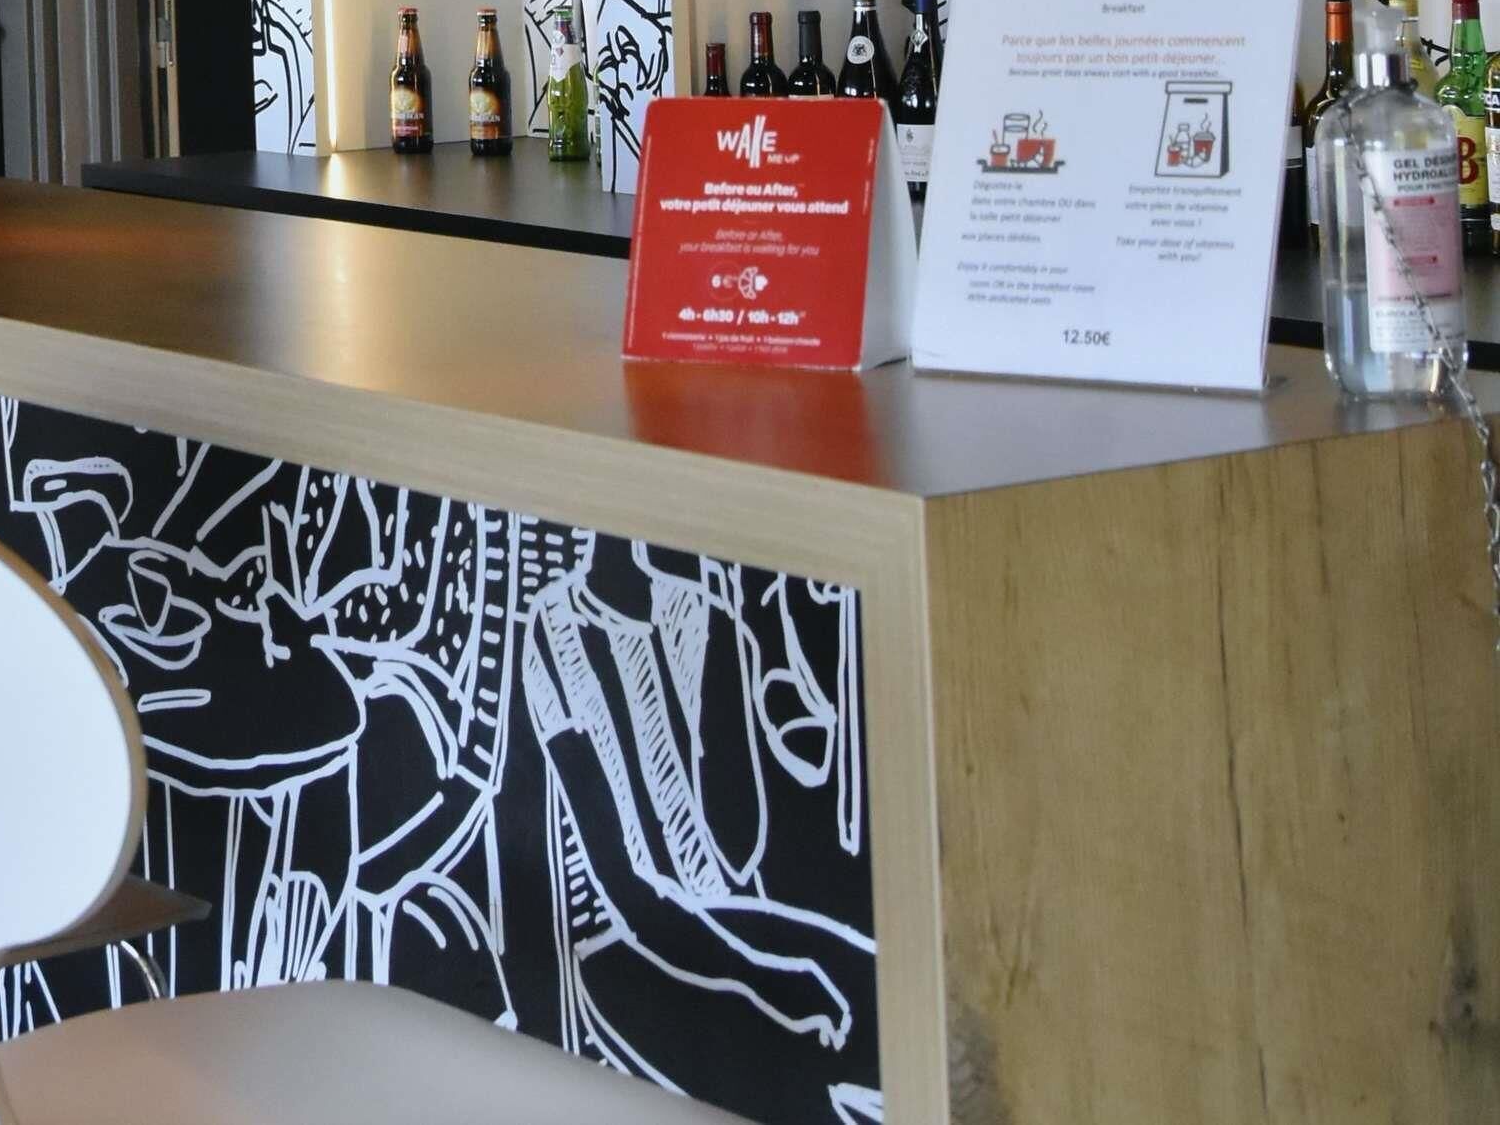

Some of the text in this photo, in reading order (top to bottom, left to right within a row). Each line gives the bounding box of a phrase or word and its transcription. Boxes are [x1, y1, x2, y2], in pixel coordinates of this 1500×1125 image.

[1002, 35, 1245, 48] Parce que les belles journées commencent
[1016, 53, 1064, 65] toujours
[1066, 54, 1085, 65] par
[1106, 53, 1129, 64] bon
[1393, 158, 1419, 169] GEL
[703, 182, 799, 198] Before ou After,
[659, 198, 849, 215] votre petit déjeuner vous attend
[1062, 329, 1111, 346] 12.50€
